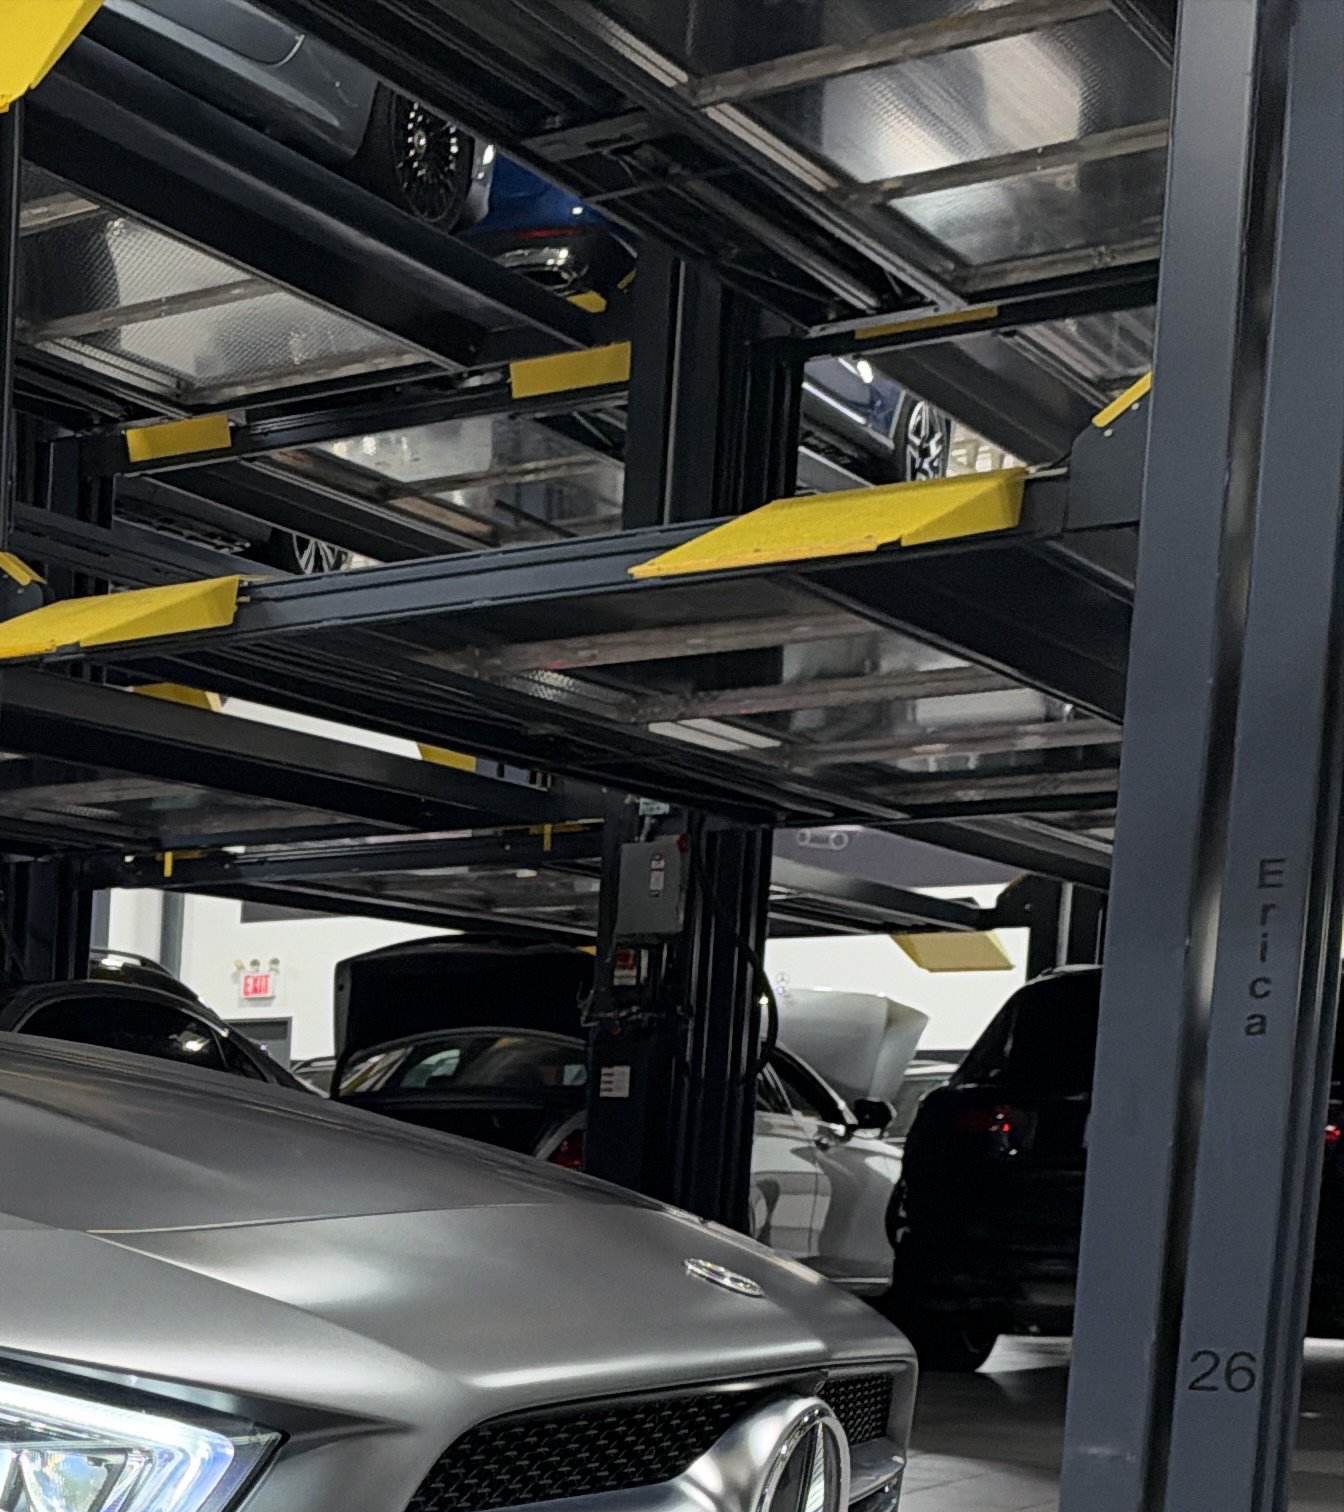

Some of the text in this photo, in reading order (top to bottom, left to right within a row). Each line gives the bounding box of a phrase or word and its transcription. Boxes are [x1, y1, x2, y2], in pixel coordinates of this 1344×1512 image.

[1244, 858, 1287, 1037] Erica
[243, 974, 269, 997] EXIT
[1188, 1349, 1256, 1393] 26
